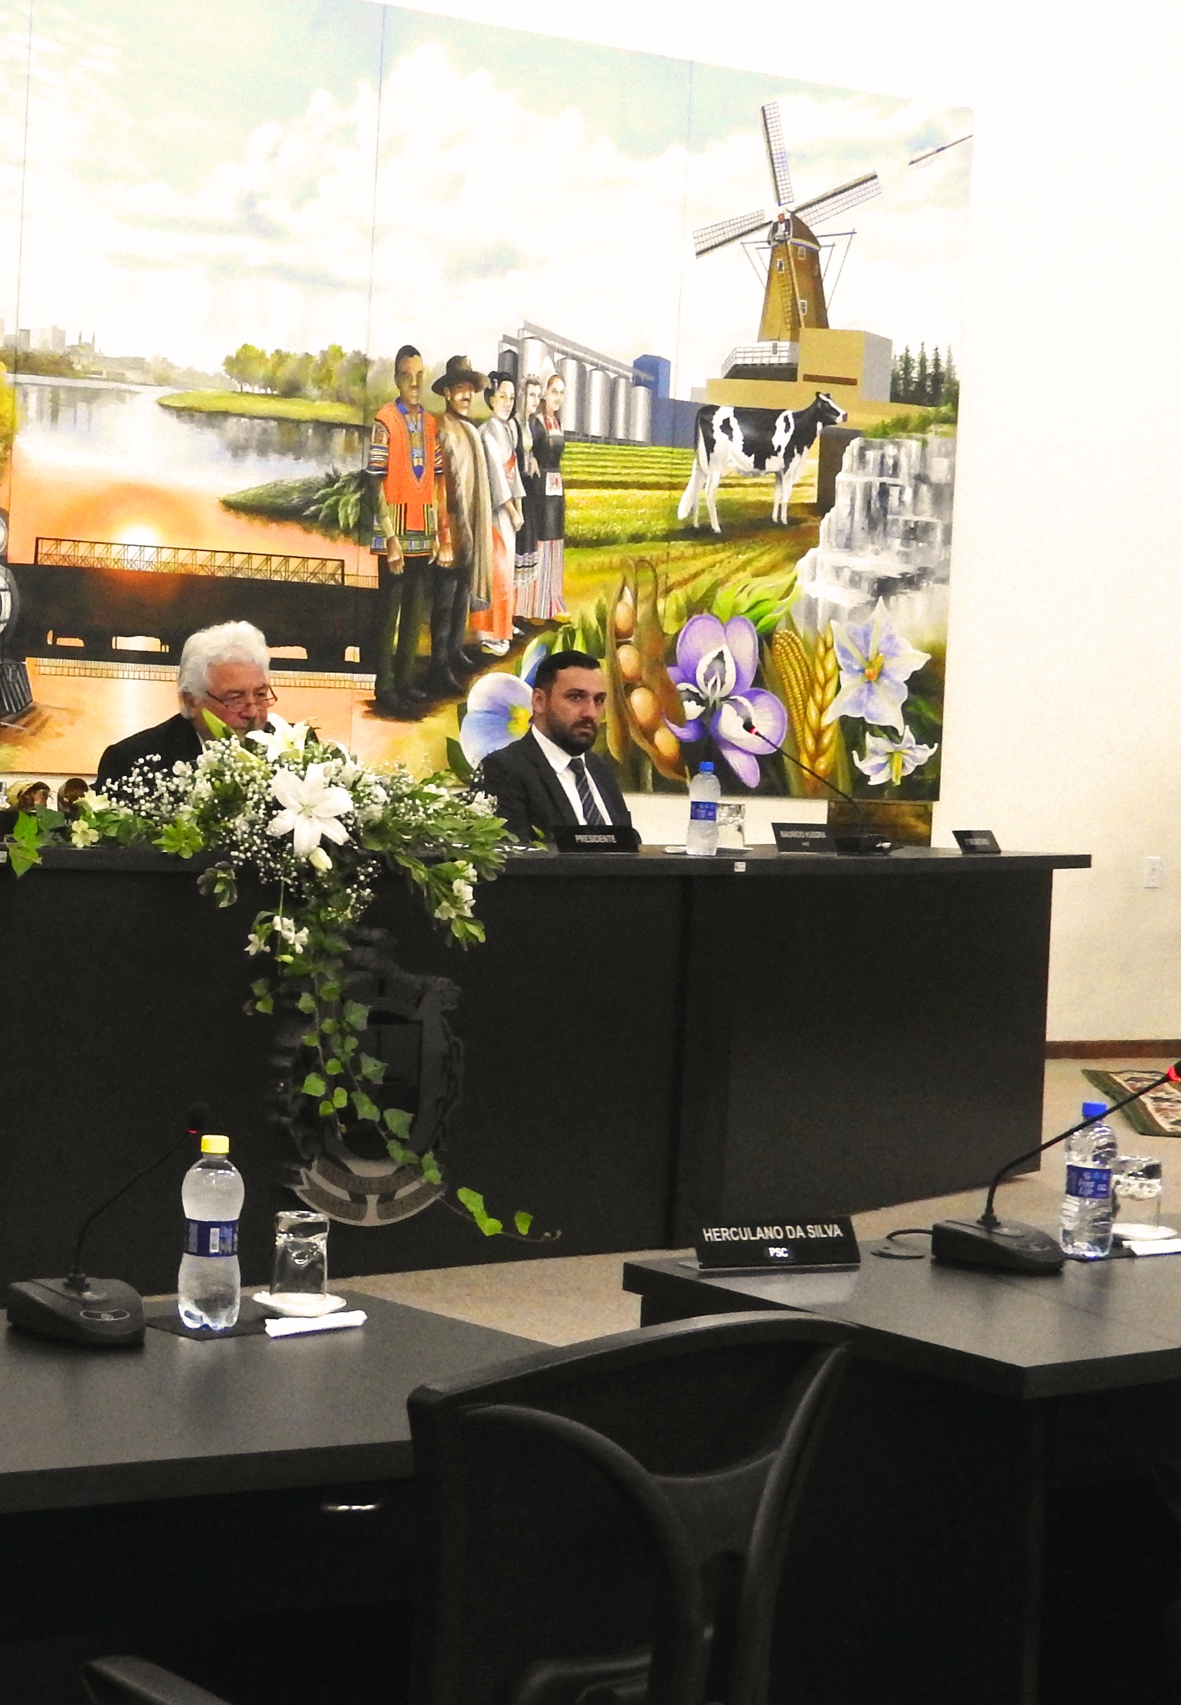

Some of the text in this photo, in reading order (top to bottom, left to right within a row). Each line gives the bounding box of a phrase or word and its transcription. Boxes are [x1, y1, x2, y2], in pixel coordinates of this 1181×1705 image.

[574, 834, 617, 843] PRESIDENTE
[702, 1223, 844, 1242] HERCULANO DA SILVA
[768, 1246, 789, 1258] PSC
